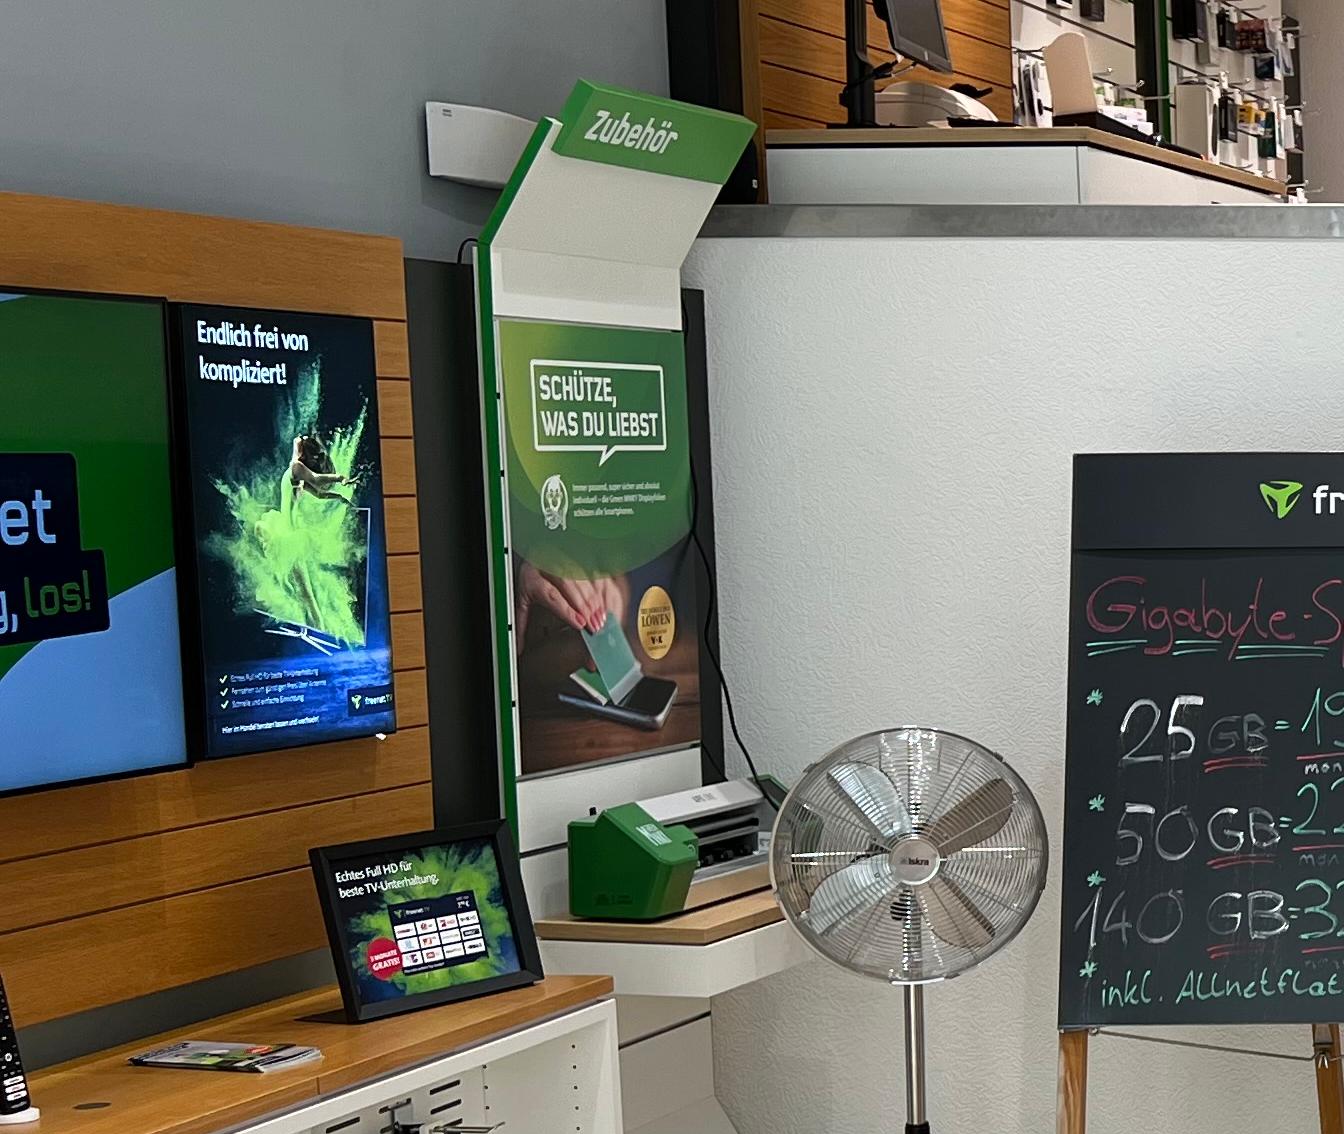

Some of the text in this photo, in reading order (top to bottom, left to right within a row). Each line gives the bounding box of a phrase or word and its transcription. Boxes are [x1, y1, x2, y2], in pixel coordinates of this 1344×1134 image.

[584, 110, 678, 154] Zubehör
[197, 320, 308, 351] Endlich frei von
[199, 355, 287, 388] kompliziert!
[539, 370, 617, 408] SCHÜTZE,
[540, 411, 659, 437] WAS DU LIEBST
[24, 570, 91, 618] los!
[1119, 695, 1204, 765] 25
[1207, 713, 1270, 754] GB
[1115, 802, 1199, 867] 50
[1207, 806, 1280, 853] GB
[335, 860, 413, 883] Echtes Full HD für
[338, 886, 365, 899] beste
[1074, 885, 1185, 949] 140
[1207, 890, 1289, 940] GB
